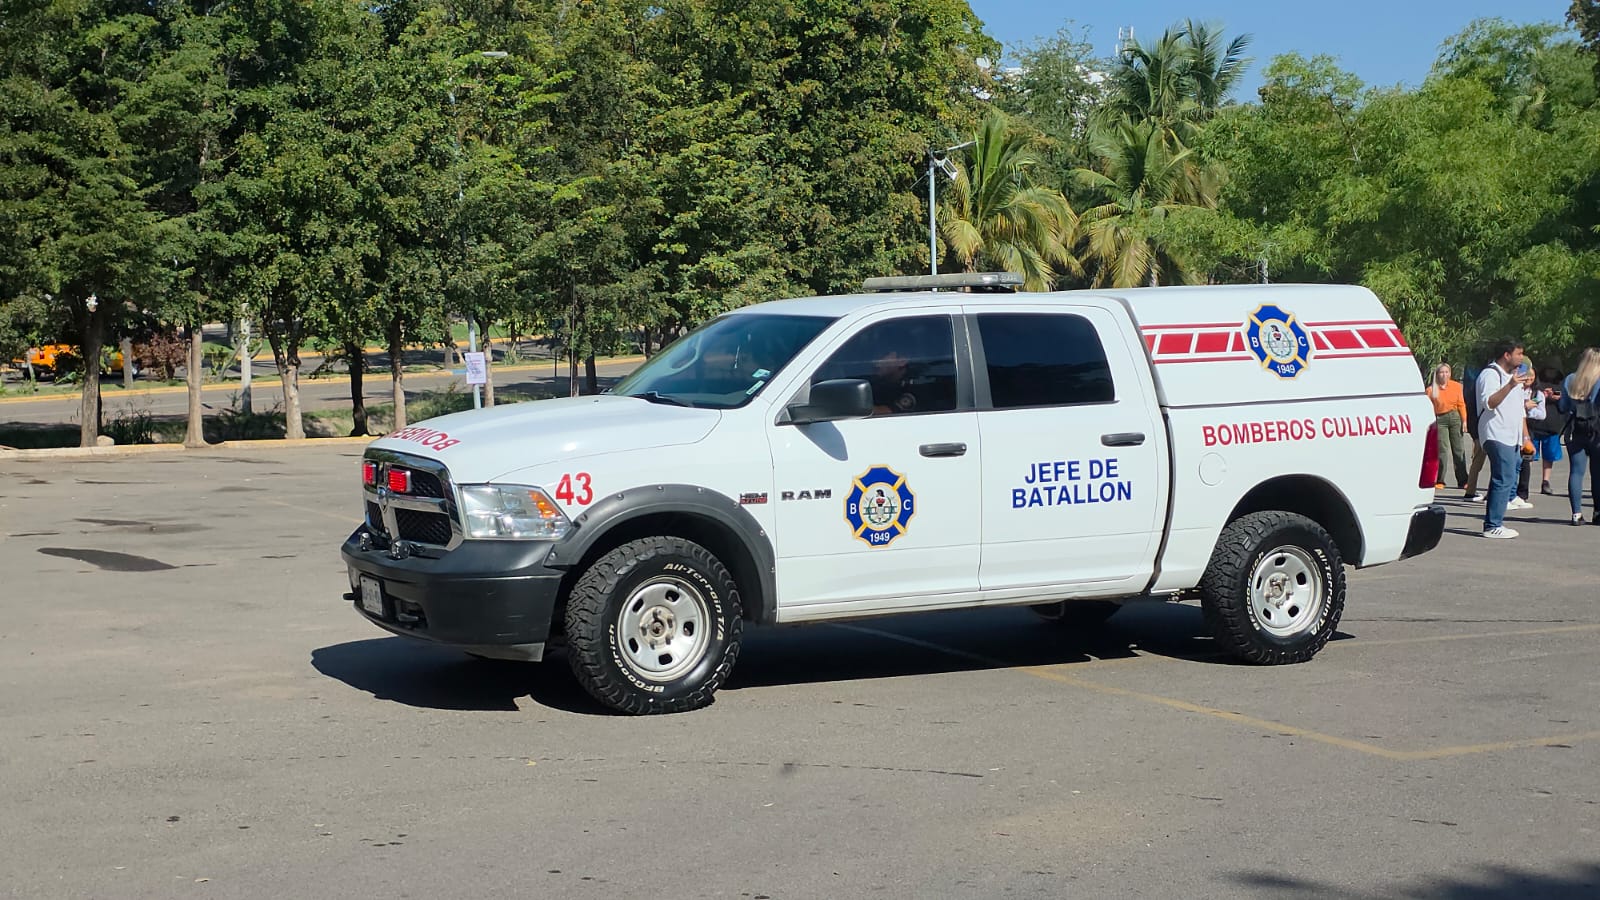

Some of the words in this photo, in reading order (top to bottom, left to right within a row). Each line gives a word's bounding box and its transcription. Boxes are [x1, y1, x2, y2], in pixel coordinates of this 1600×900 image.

[1251, 336, 1259, 348] B
[1298, 336, 1307, 347] C
[1276, 364, 1296, 375] 1949
[1202, 418, 1316, 447] BOMBEROS
[1321, 414, 1412, 439] CULIACAN
[1024, 460, 1081, 484] JEFE
[1089, 458, 1119, 480] DE
[555, 472, 593, 506] 43
[781, 489, 832, 501] RAM
[1012, 480, 1131, 509] BATALLON
[850, 503, 857, 515] B
[903, 499, 911, 511] C
[869, 532, 890, 543] 1949
[716, 615, 725, 641] T/A
[608, 623, 665, 693] BFGoodrich
